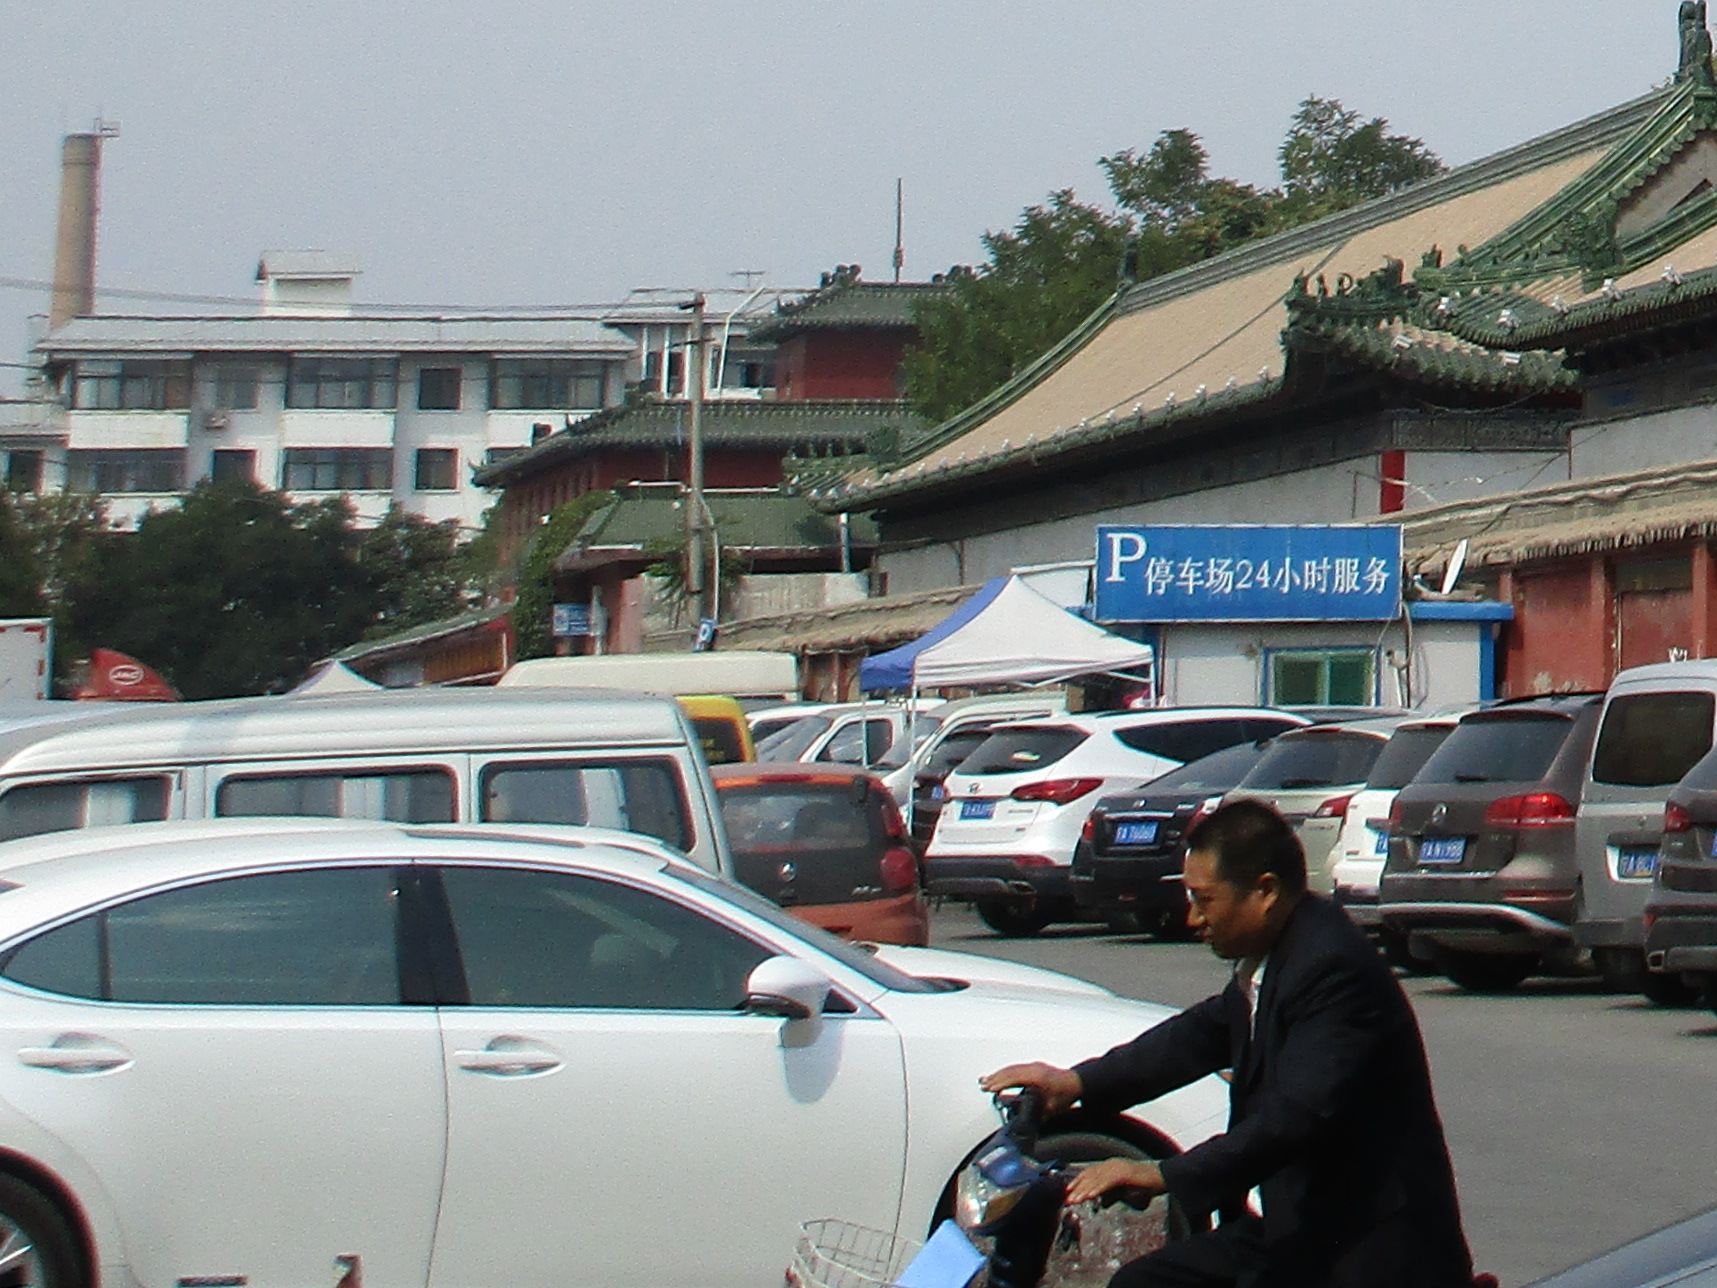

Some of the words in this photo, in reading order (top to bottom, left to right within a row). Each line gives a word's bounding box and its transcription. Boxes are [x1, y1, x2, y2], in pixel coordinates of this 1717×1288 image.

[1105, 532, 1147, 583] P
[1144, 556, 1391, 596] 停车场24小时服务
